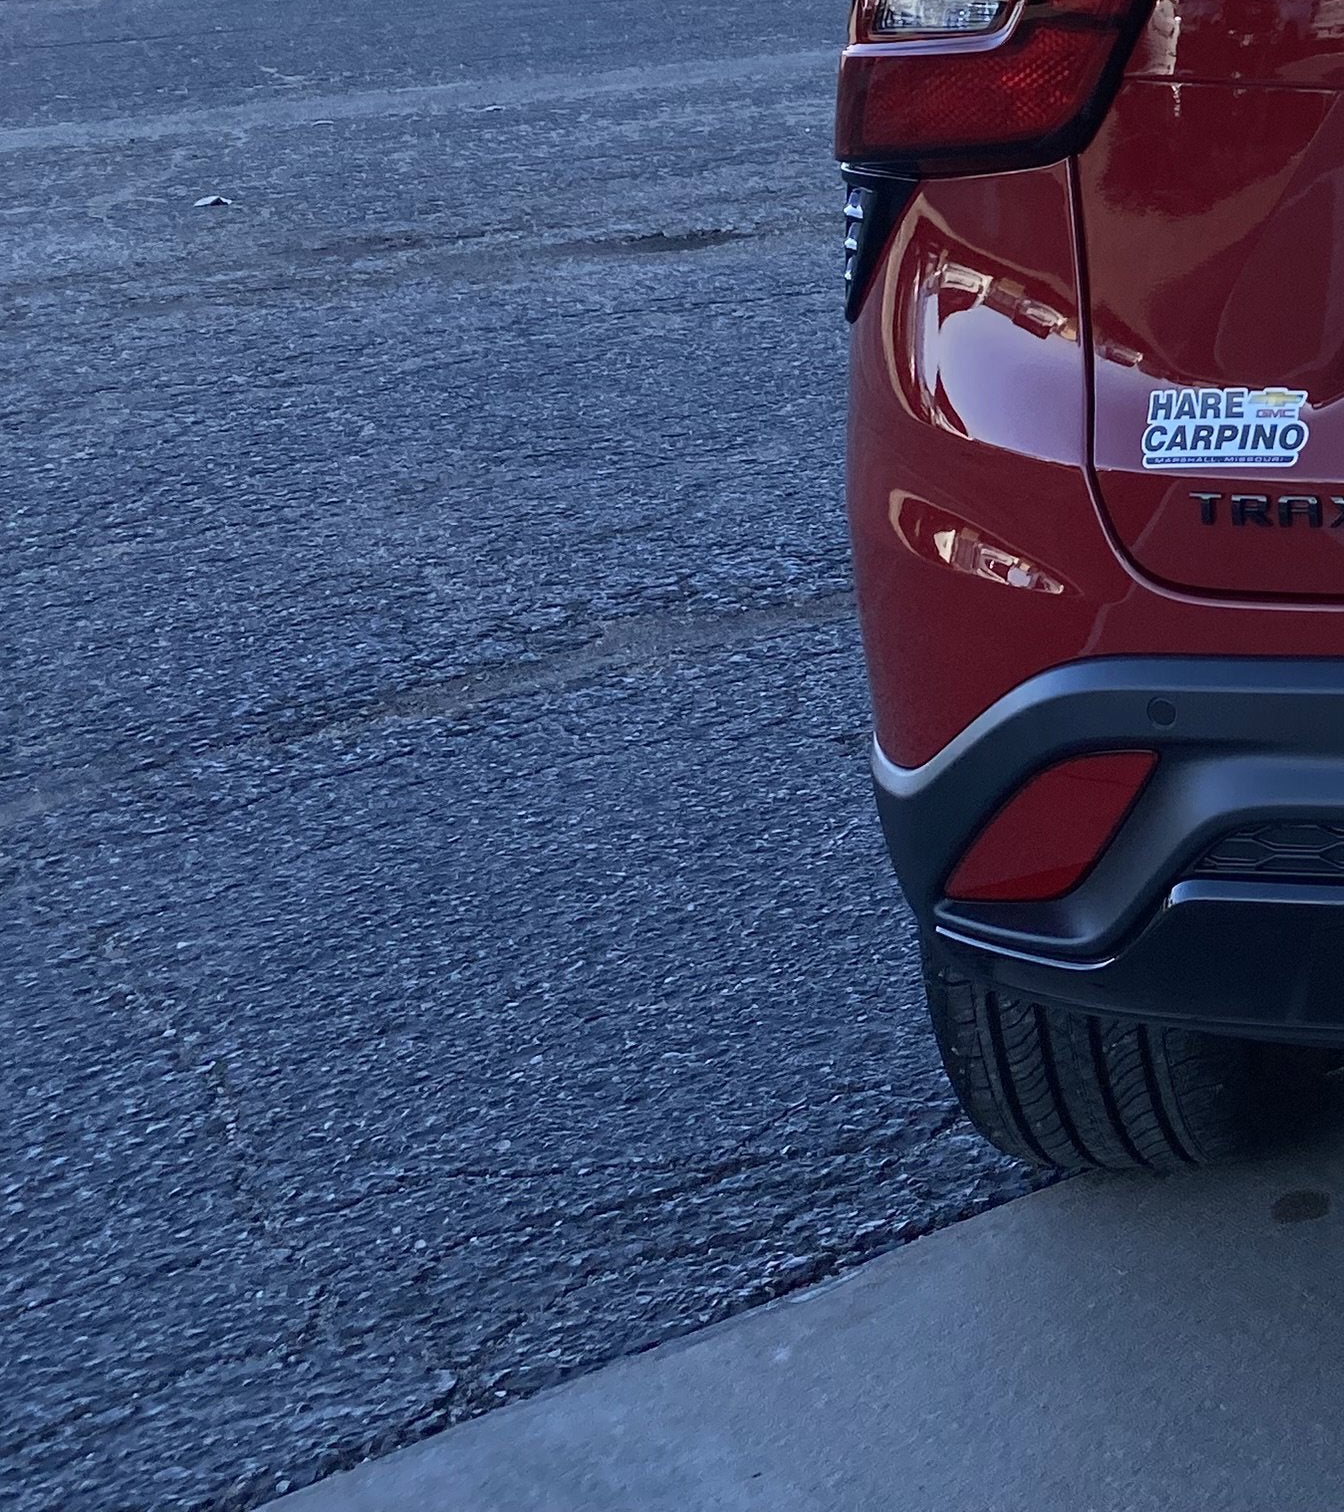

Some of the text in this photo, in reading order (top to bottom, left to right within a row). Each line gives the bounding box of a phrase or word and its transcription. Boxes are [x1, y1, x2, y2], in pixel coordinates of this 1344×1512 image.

[1150, 391, 1245, 420] HARE
[1256, 408, 1296, 419] GMC
[1144, 423, 1305, 452] CARPINO
